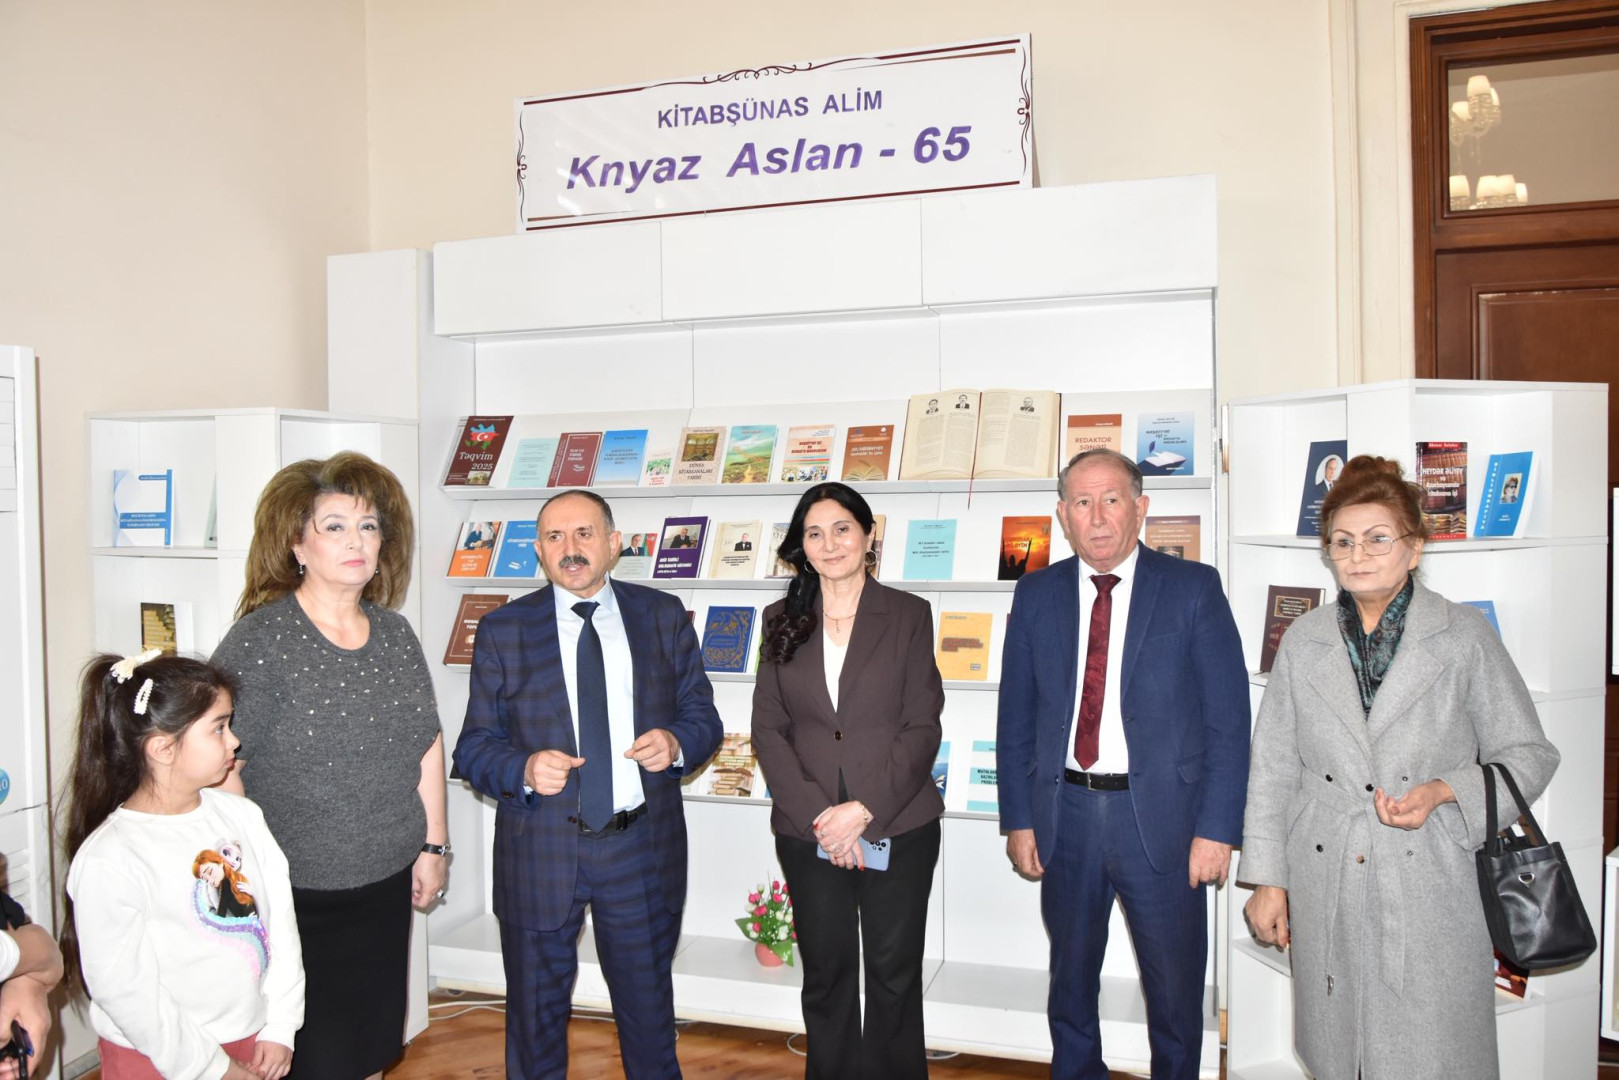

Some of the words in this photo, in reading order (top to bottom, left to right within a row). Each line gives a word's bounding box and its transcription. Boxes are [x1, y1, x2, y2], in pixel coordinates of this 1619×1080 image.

[657, 96, 809, 128] KİTABŞÜNAS
[823, 89, 883, 114] ALİM
[567, 154, 702, 193] Knyaz
[727, 139, 864, 178] Aslan
[879, 148, 896, 158] -
[913, 125, 972, 164] 65
[459, 451, 493, 461] Təqvim
